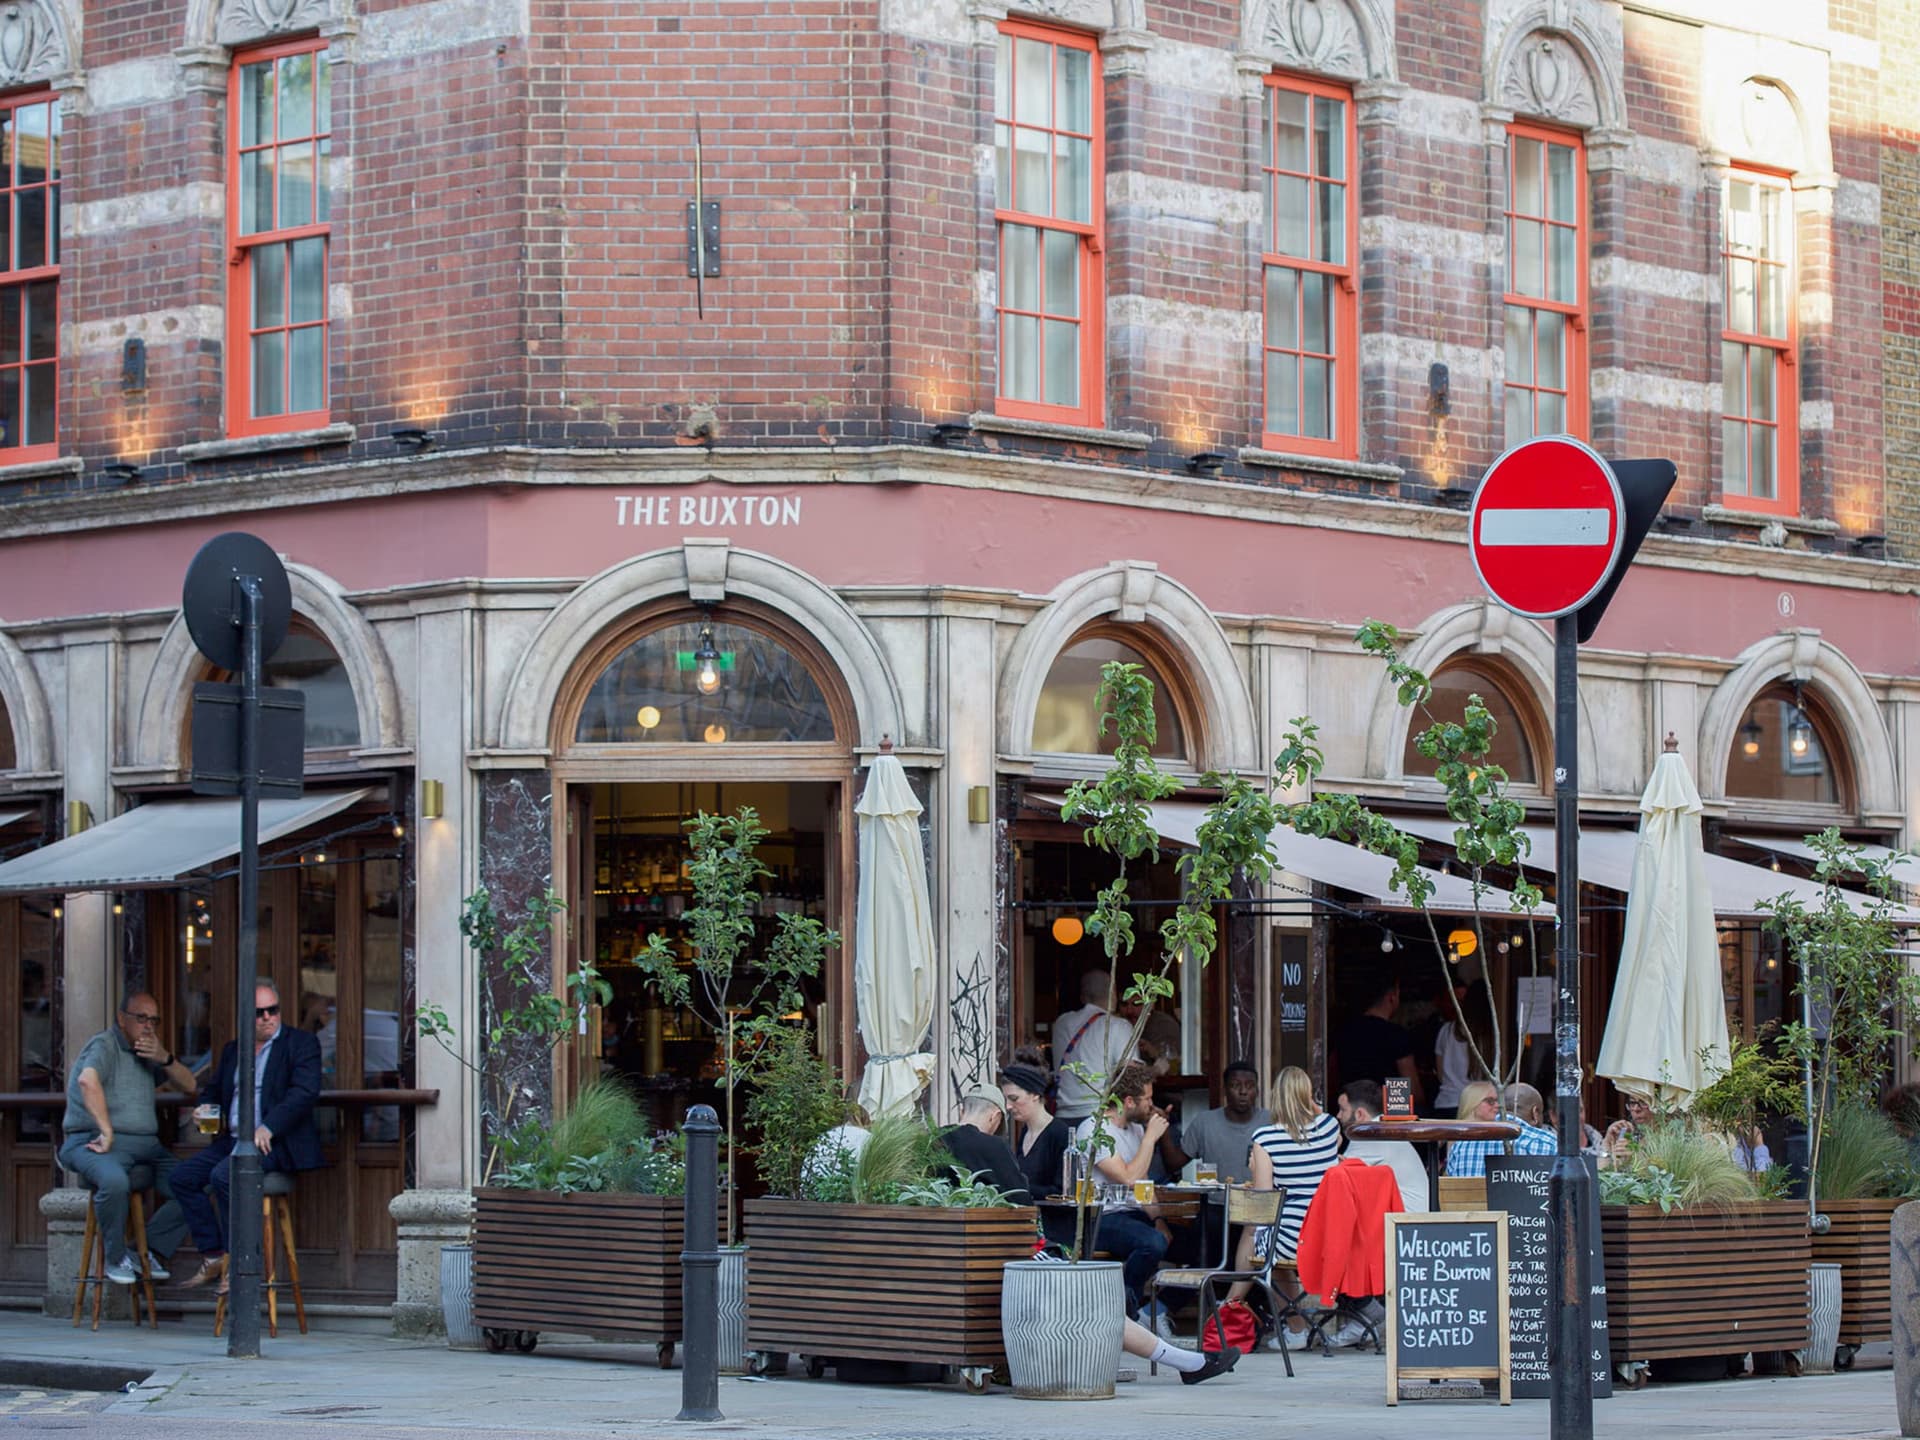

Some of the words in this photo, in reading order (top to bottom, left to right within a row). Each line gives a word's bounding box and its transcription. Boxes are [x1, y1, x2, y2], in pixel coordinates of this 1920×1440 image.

[615, 496, 671, 526] THE
[678, 496, 801, 526] BUXTON
[1283, 962, 1302, 986] NO
[1386, 1080, 1408, 1088] PLEASE
[1492, 1169, 1549, 1183] ENTRANCE
[1527, 1184, 1549, 1196] THI
[1398, 1229, 1472, 1258] WELCOME
[1469, 1232, 1492, 1257] TO
[1399, 1262, 1429, 1281] THE
[1433, 1259, 1491, 1281] BUXTON
[1528, 1261, 1546, 1271] TAR
[1400, 1287, 1459, 1308] PLEASE
[1508, 1286, 1531, 1296] RUDO
[1401, 1308, 1443, 1326] WAIT
[1445, 1310, 1463, 1324] TO
[1468, 1309, 1488, 1325] BE
[1402, 1327, 1474, 1348] SEATED
[1510, 1351, 1536, 1361] OLENTA
[1510, 1361, 1549, 1372] HOCOLATE
[1511, 1371, 1551, 1381] ELECTION
